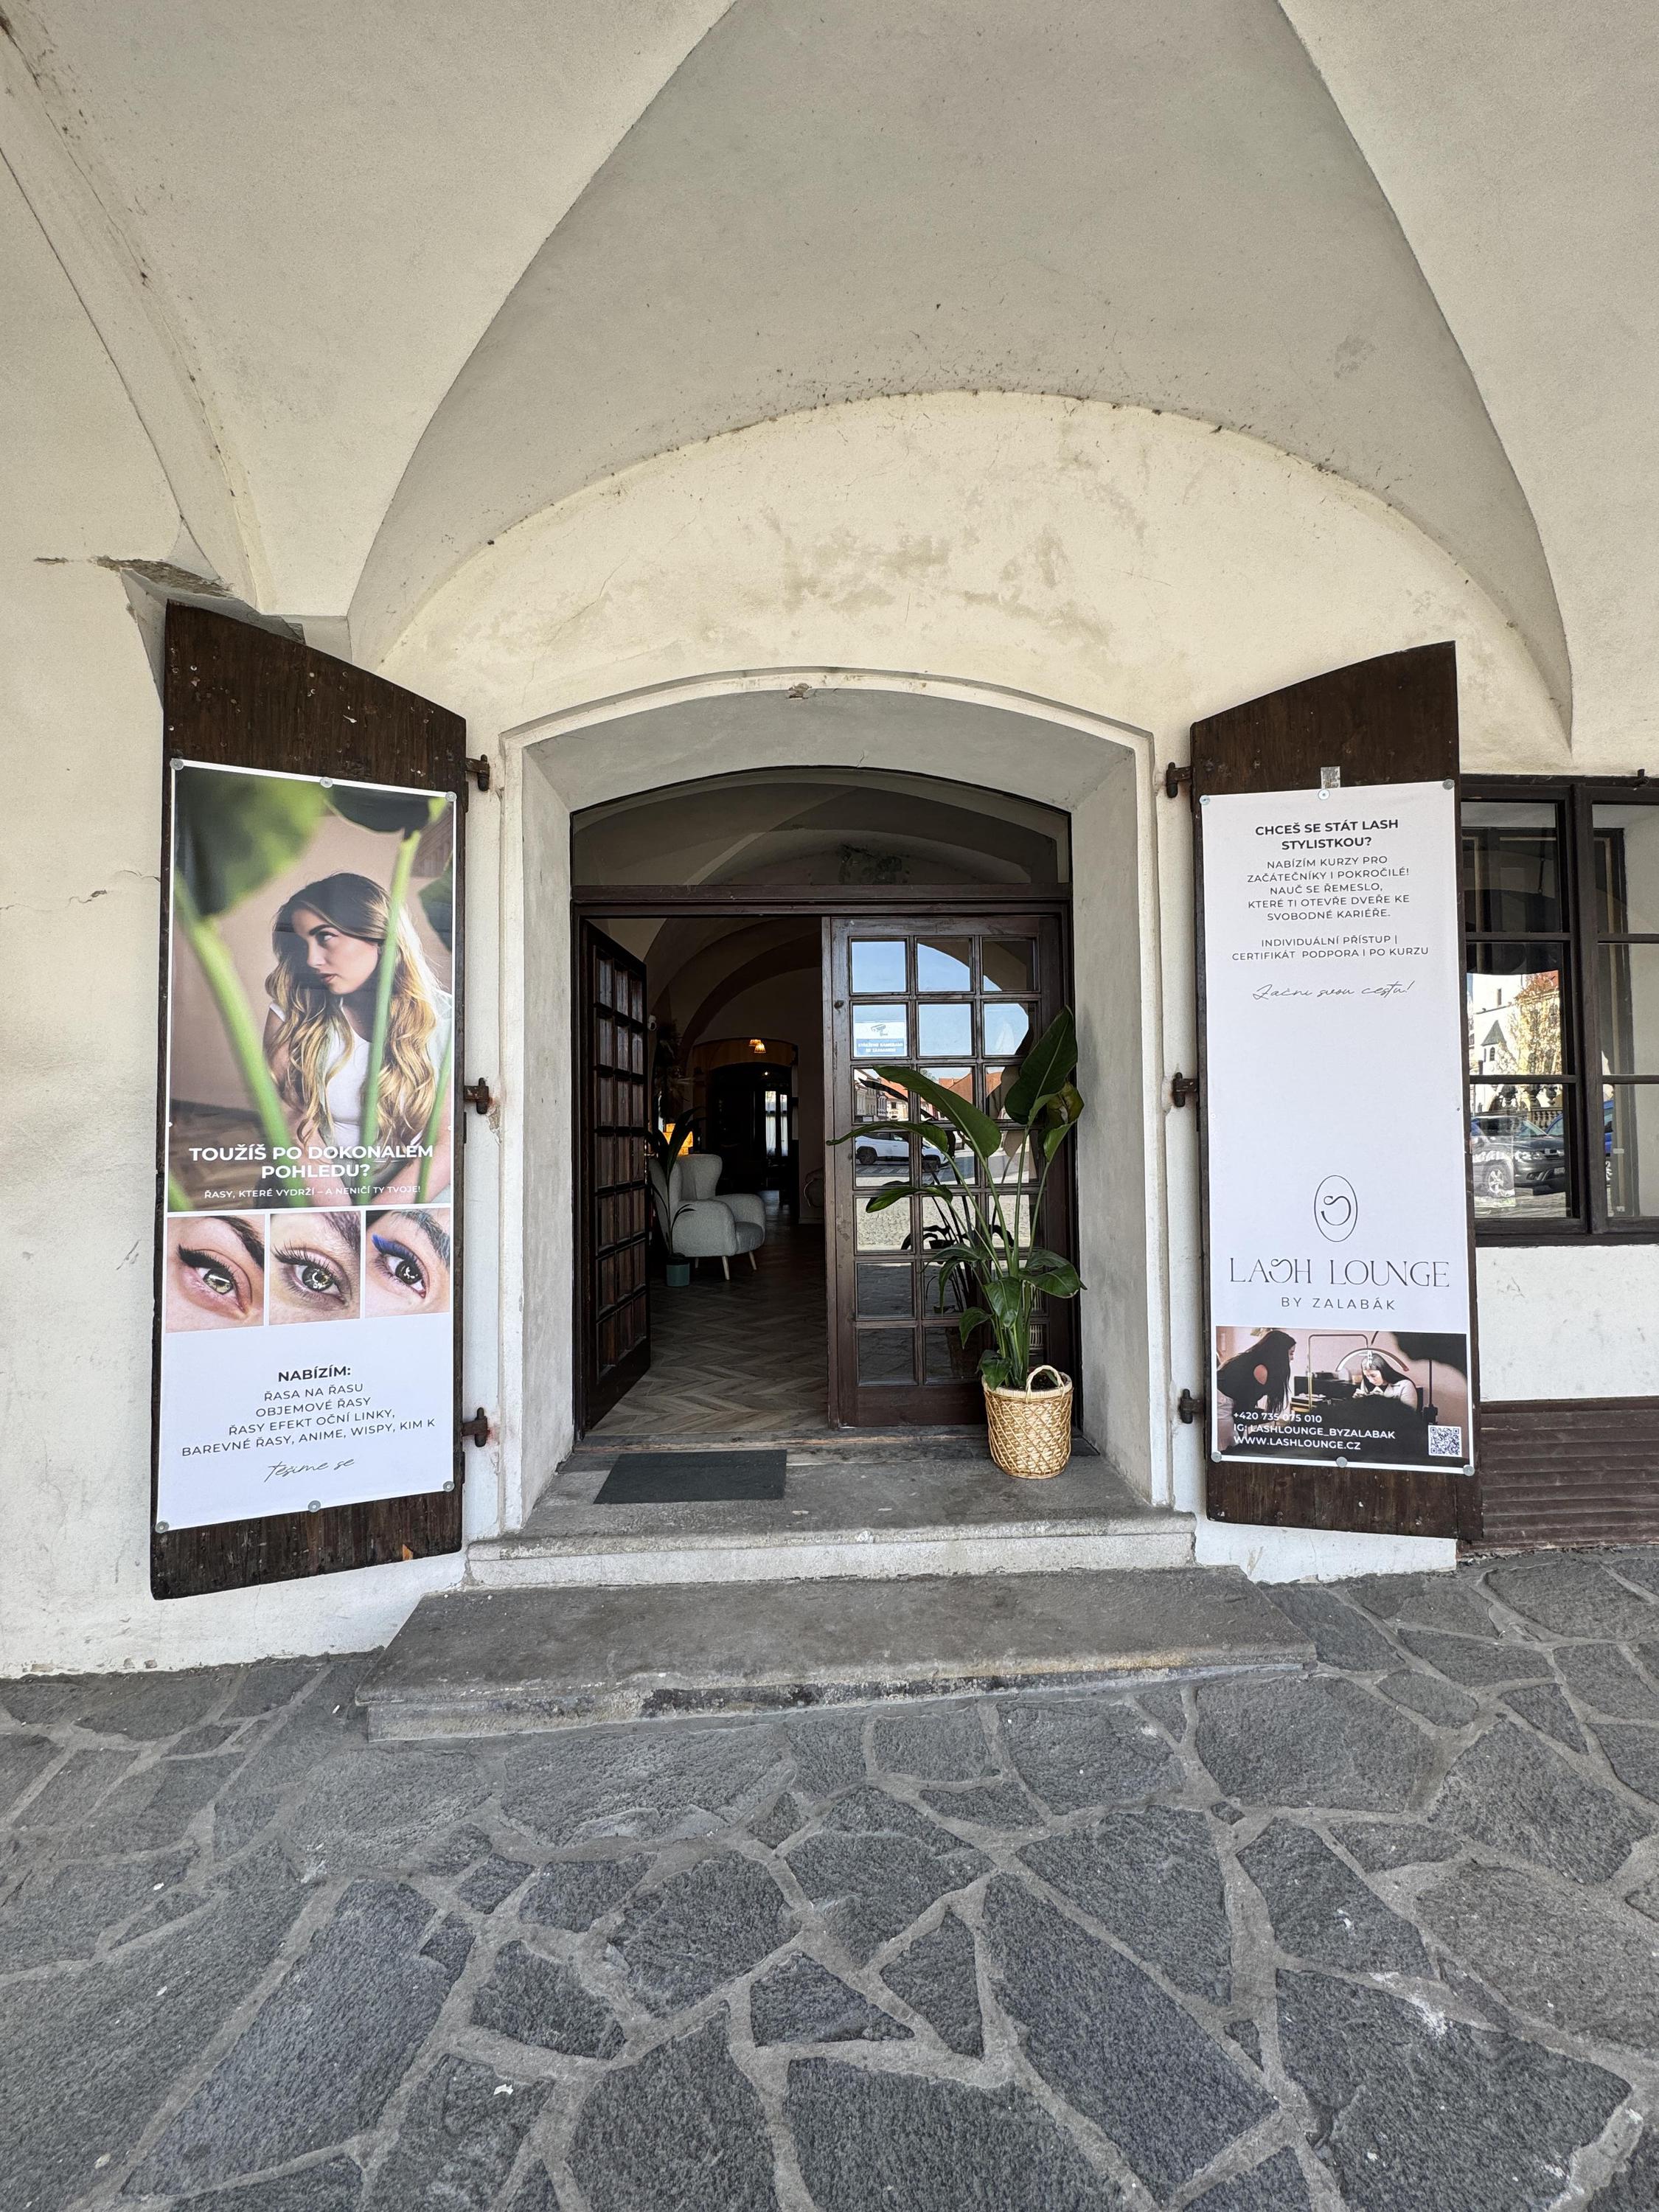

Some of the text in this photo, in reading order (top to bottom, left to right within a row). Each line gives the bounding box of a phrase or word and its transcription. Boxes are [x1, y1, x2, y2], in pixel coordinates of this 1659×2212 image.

[1256, 819, 1398, 835] CHCEŠ SE STÁT LASH
[1281, 837, 1372, 850] STYLISTKOU?
[1267, 856, 1387, 869] NABÍZÍM KURZY PRO
[1247, 871, 1328, 884] ZAČÁTEČNÍKY
[1338, 866, 1410, 879] POKROČILÉ!
[1270, 883, 1382, 895] NAUČ SE ŘEMESLO,
[1248, 897, 1284, 908] KTERÉ
[1301, 894, 1347, 908] OTEVŘE
[1352, 894, 1391, 905] DVEŘE
[1394, 894, 1410, 902] KE
[1267, 908, 1391, 921] SVOBODNÉ KARIÉŘE.
[1262, 933, 1340, 947] INDIVIDUÁLNÍ
[1343, 933, 1392, 945] PŘÍSTUP
[1232, 949, 1295, 961] CERTIFIKÁT
[1302, 950, 1360, 959] PODPORA
[1389, 947, 1428, 956] KURZU
[189, 1143, 434, 1161] TOUŽÍŠ PO DOKONALÉM
[261, 1164, 370, 1179] POHLEDU?
[204, 1189, 236, 1199] ŘASY,
[238, 1187, 274, 1197] KTERÉ
[276, 1186, 315, 1197] VYDRŽÍ
[325, 1186, 333, 1195] A
[335, 1185, 370, 1194] NENIČÍ
[372, 1186, 384, 1194] TY
[387, 1185, 421, 1193] TVOJE!
[1230, 1258, 1450, 1287] LASH LOUNGE
[1281, 1297, 1395, 1310] BY ZALABÁK
[278, 1365, 350, 1382] NABÍZÍM:
[264, 1383, 363, 1402] ŘASA NA ŘASU
[256, 1397, 371, 1419] OBJEMOVÉ ŘASY
[229, 1409, 394, 1437] ŘASY EFEKT OČNÍ LINKY,
[1233, 1411, 1322, 1422] +420 735 075 010
[182, 1419, 437, 1456] BAREVNÉ ŘASY, ANIME, WISPY, KIM K
[1234, 1423, 1396, 1439] IG: LASHLOUNGE_BYZALABAK
[1234, 1436, 1361, 1450] WWW.LASHLOUNGE.CZ
